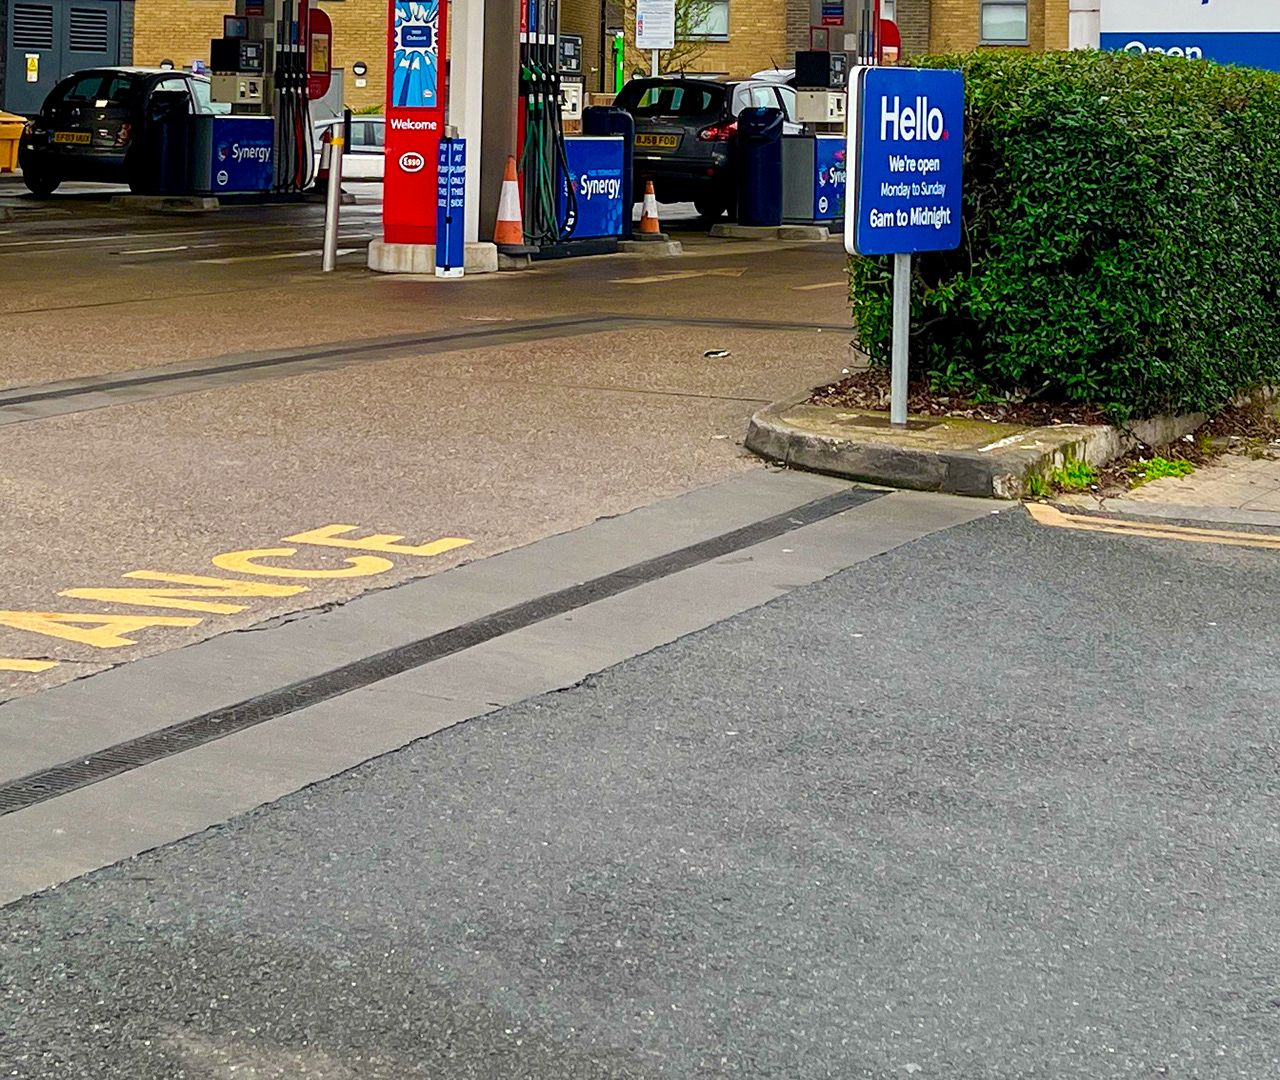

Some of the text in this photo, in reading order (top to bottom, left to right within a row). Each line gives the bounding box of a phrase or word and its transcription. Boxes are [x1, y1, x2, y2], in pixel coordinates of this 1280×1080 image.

[390, 118, 437, 130] Welcome
[880, 95, 949, 141] Hello.
[231, 143, 271, 162] Synergy
[403, 156, 421, 167] Esso
[888, 154, 940, 176] We're open
[450, 176, 465, 185] ONLY
[829, 166, 846, 188] Syne
[451, 187, 464, 196] THIS
[580, 174, 620, 200] Synergy
[880, 181, 946, 199] Monday to Sunday
[450, 198, 464, 207] SIDE
[870, 206, 951, 230] 6am to Midnight
